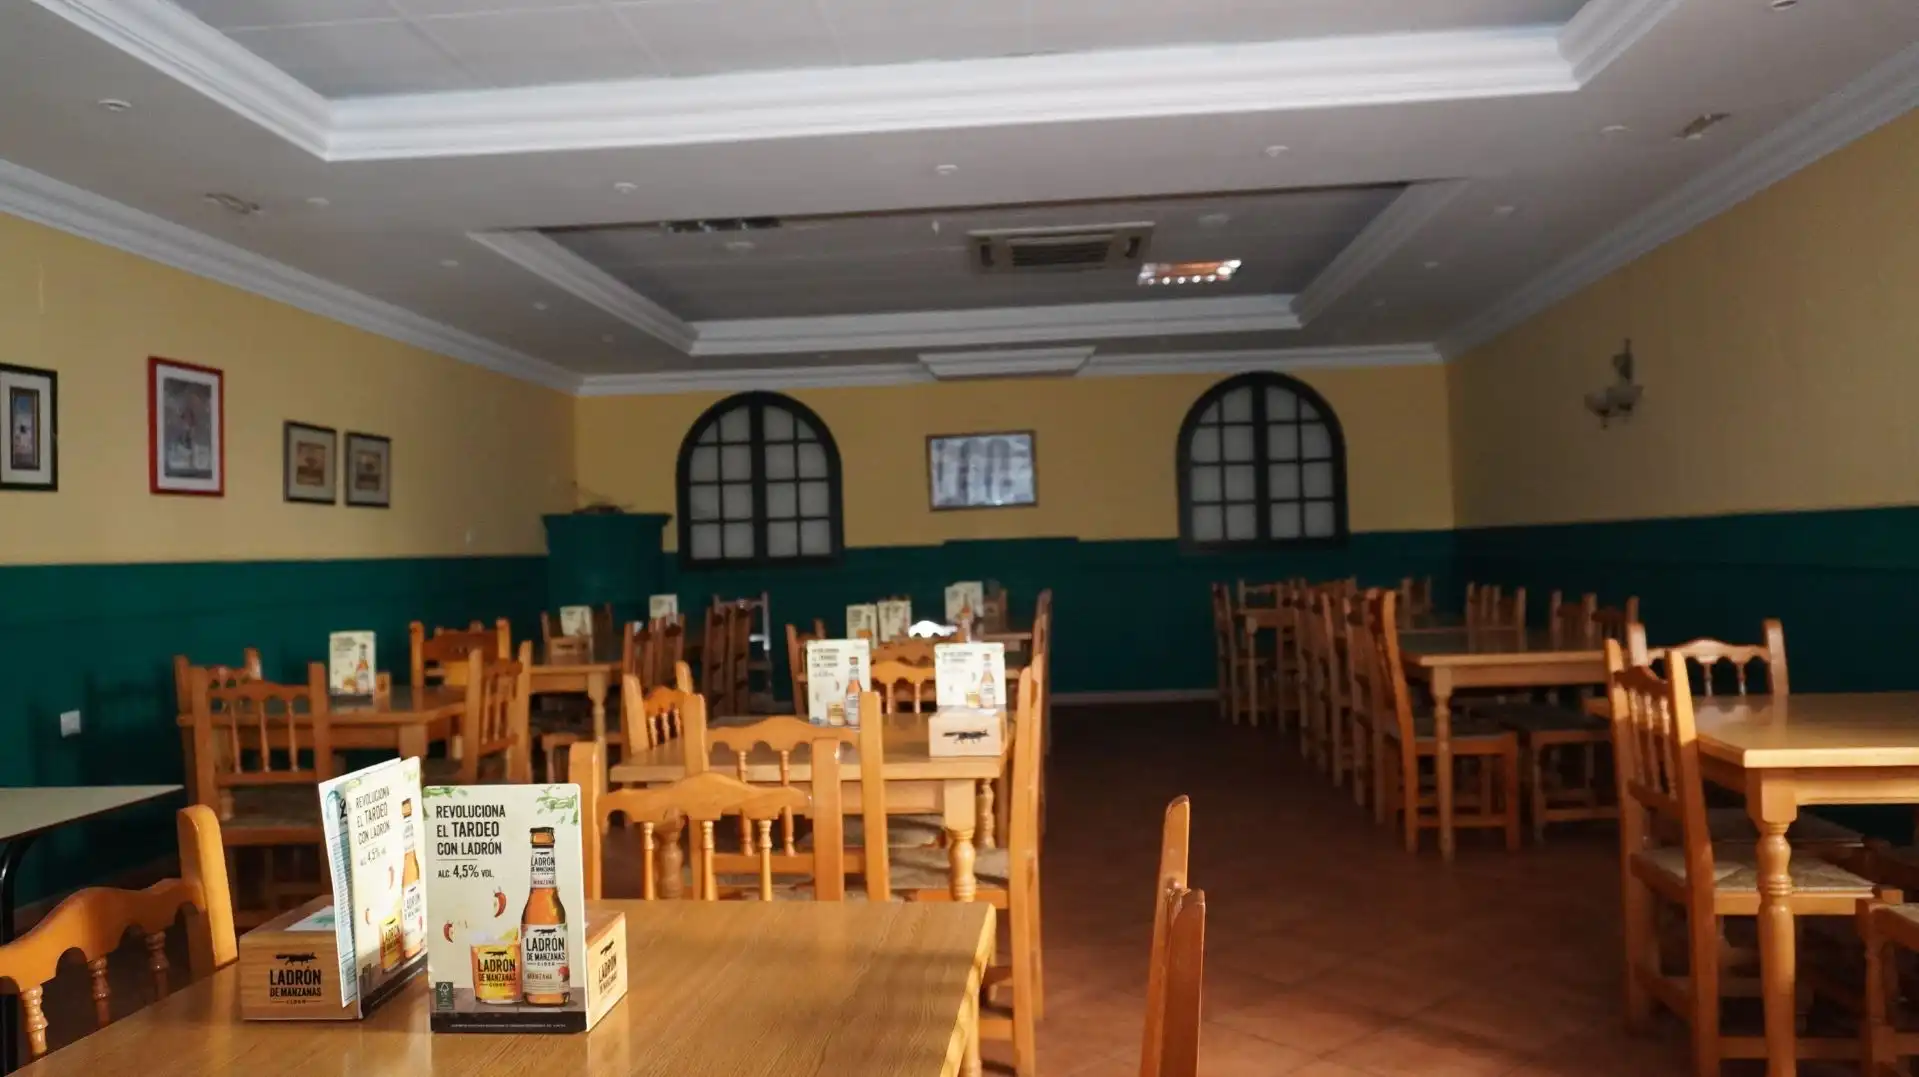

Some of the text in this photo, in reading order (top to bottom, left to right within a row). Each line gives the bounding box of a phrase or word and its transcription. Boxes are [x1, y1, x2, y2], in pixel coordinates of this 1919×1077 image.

[357, 815, 363, 828] EL
[365, 802, 388, 824] TARDEO
[436, 804, 506, 818] REVOLUCIONA
[436, 821, 500, 838] EL TARDEO
[357, 831, 370, 845] CON
[437, 838, 502, 856] CON LADRÓN
[453, 864, 479, 879] 4,5%
[525, 935, 565, 951] LADRÓN
[526, 952, 565, 961] DE MANZANAS
[269, 966, 322, 985] LADRÓN
[270, 987, 322, 997] DE MANZANAS
